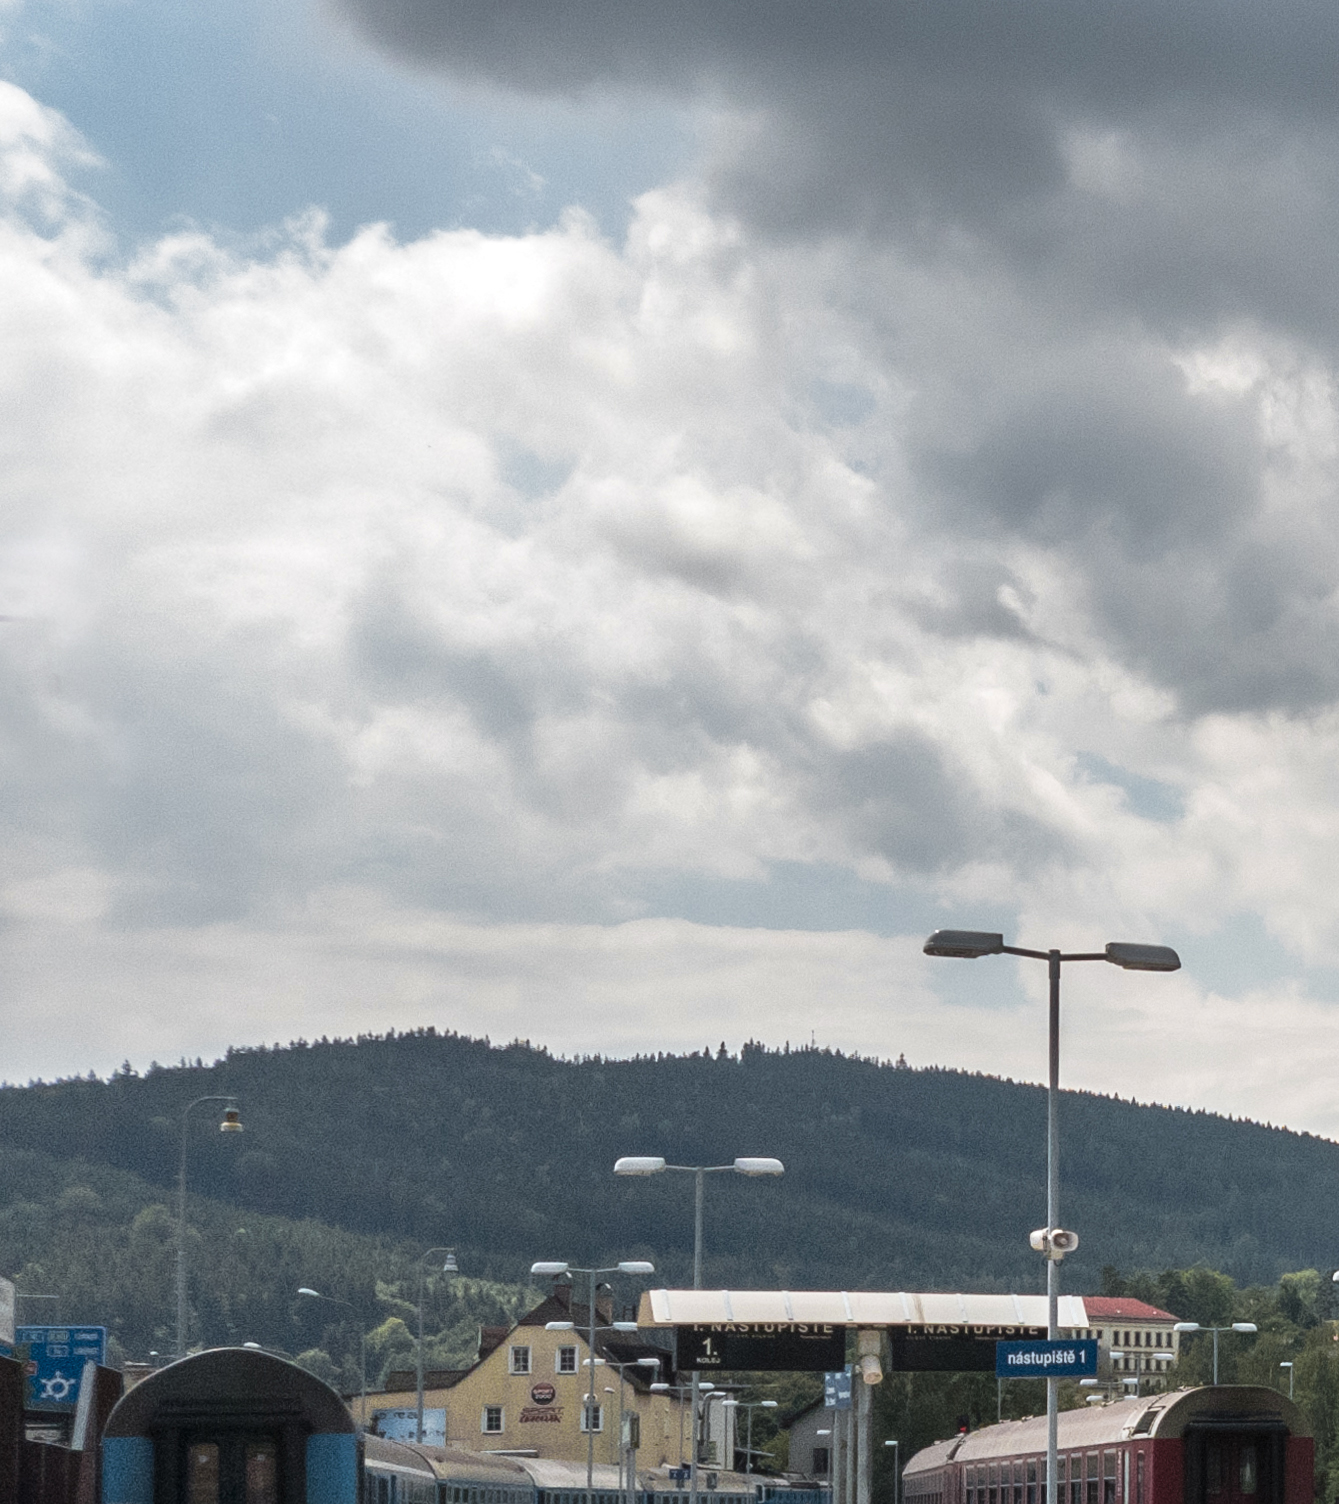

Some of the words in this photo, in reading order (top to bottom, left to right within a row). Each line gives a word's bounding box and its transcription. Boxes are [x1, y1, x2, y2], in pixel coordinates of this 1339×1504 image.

[702, 1337, 718, 1356] 1.
[1007, 1350, 1076, 1367] nástupiště
[1079, 1349, 1086, 1364] 1
